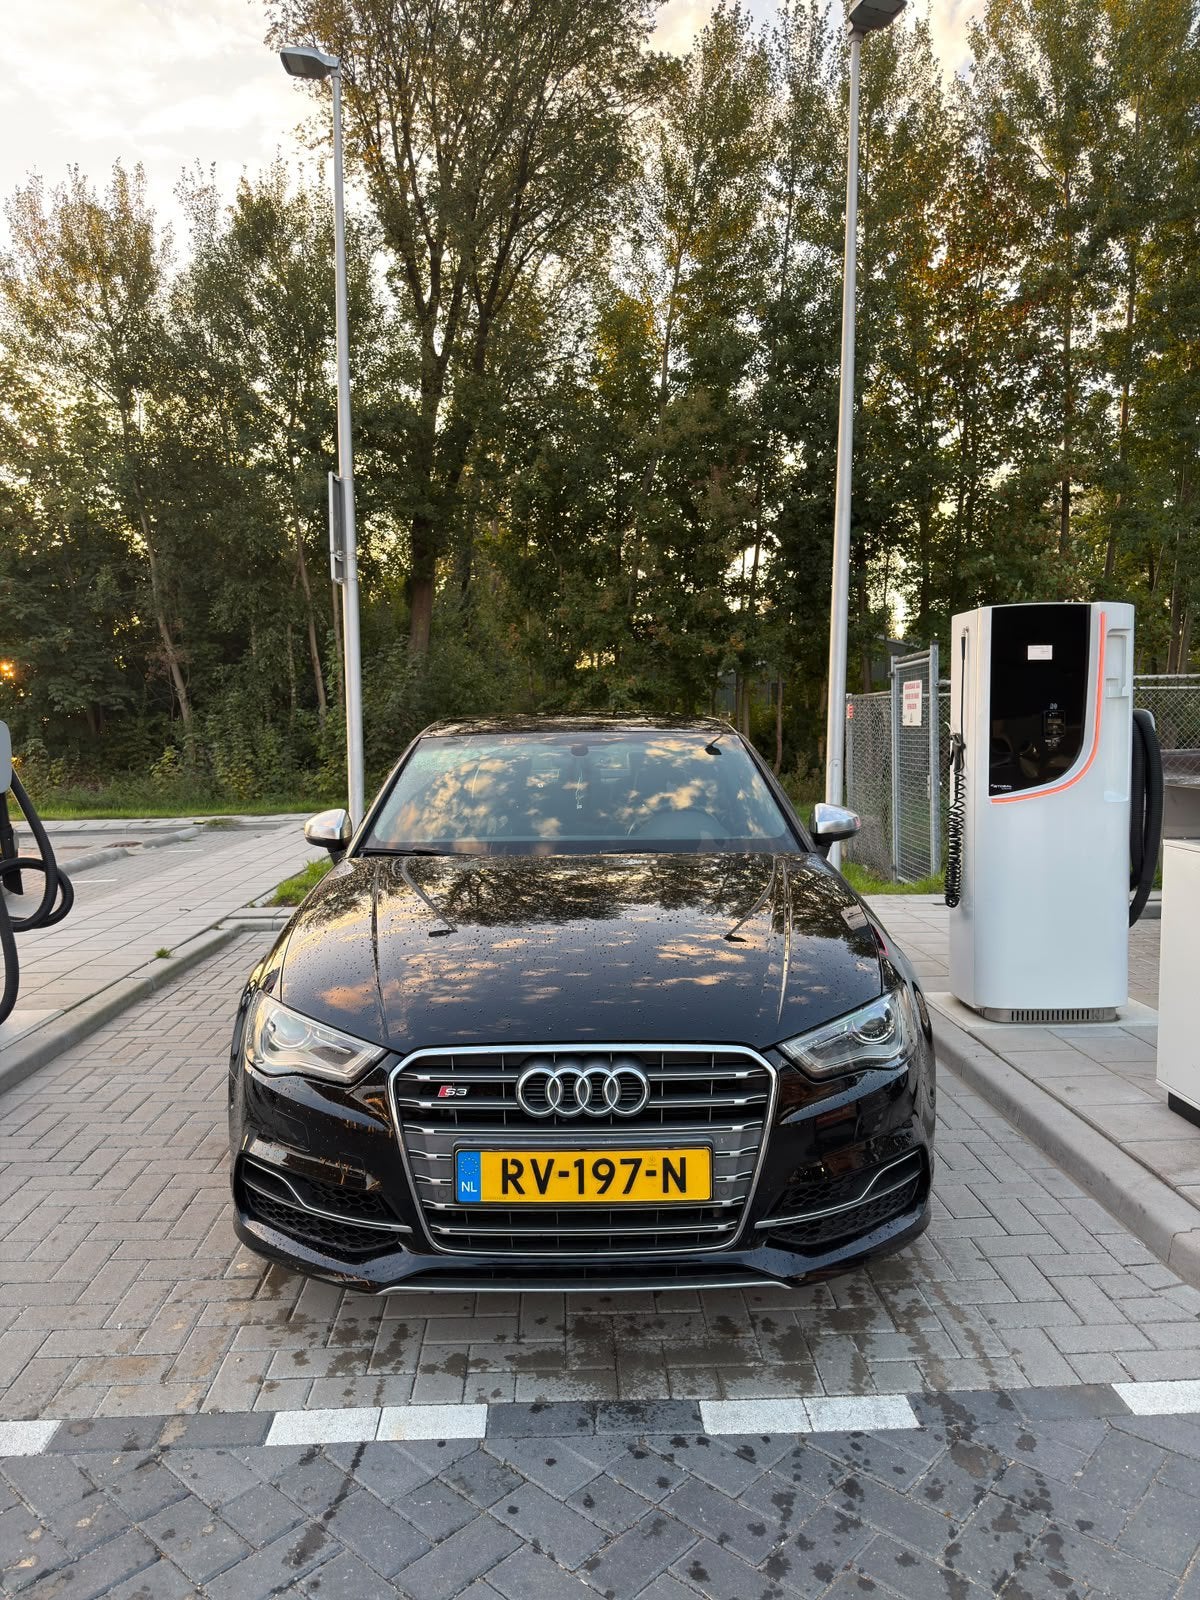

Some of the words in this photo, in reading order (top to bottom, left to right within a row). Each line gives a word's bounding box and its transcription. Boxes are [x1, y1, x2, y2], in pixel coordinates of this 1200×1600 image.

[442, 1087, 468, 1097] S3
[501, 1157, 687, 1195] RV-197-N
[461, 1180, 478, 1193] NL
